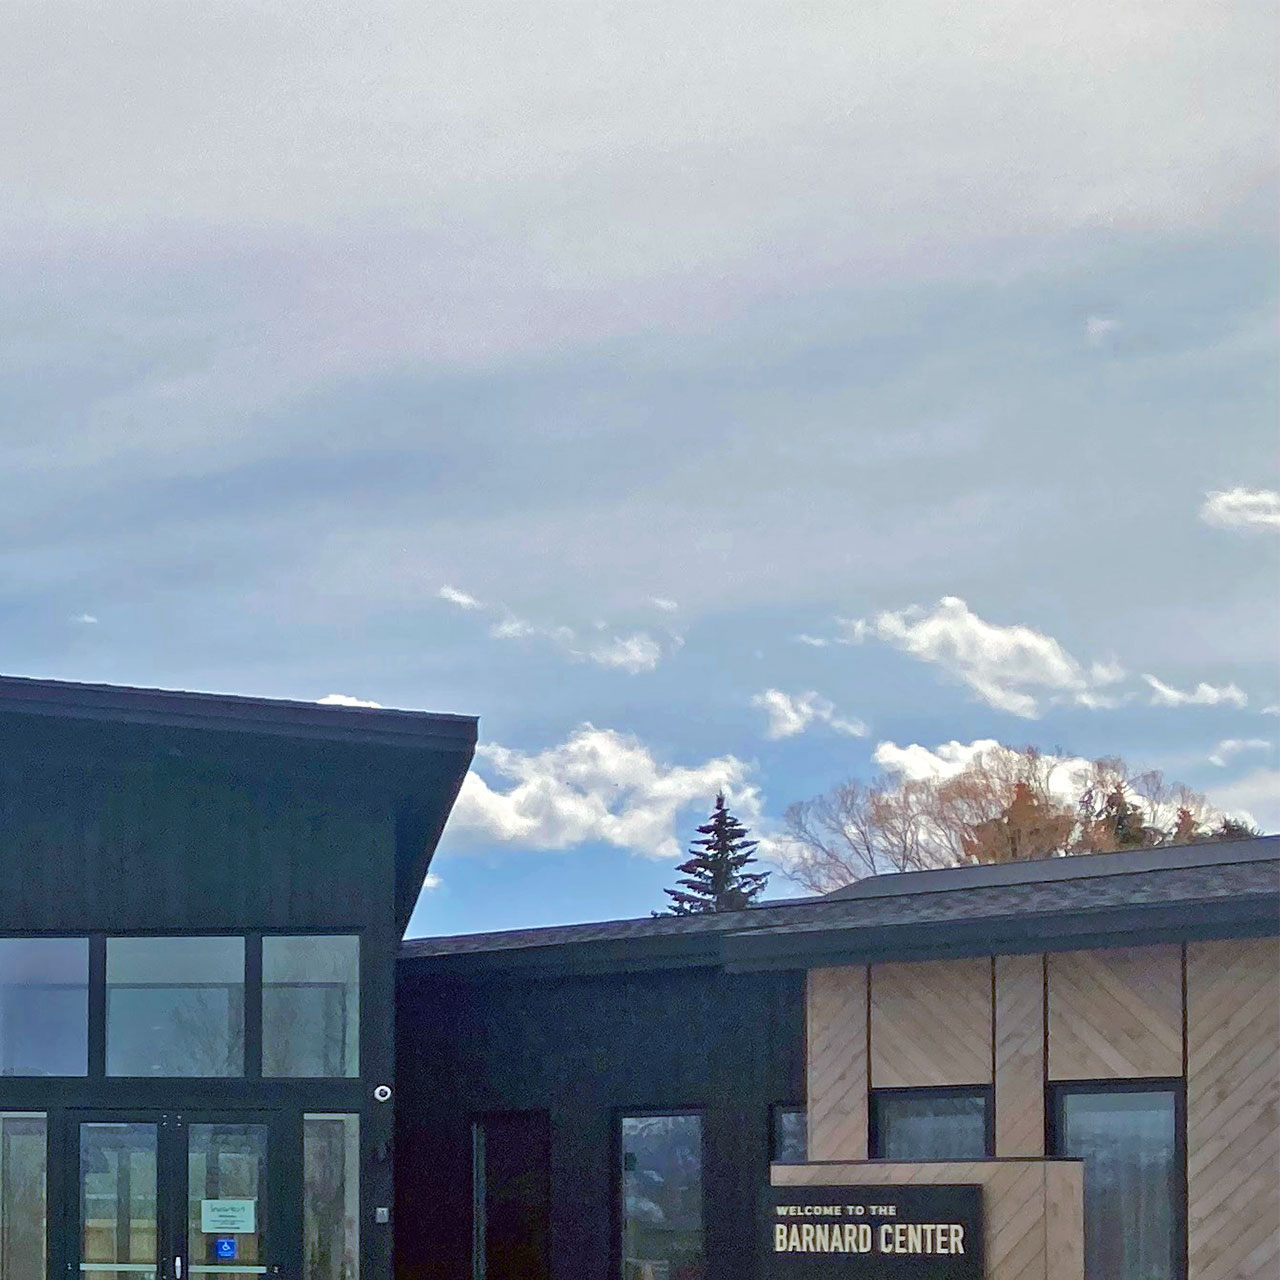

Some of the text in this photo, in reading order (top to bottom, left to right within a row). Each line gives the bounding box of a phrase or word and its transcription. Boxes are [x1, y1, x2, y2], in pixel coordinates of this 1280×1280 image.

[776, 1205, 897, 1216] WELCOME TO THE
[775, 1223, 965, 1254] BARNARD CENTER
